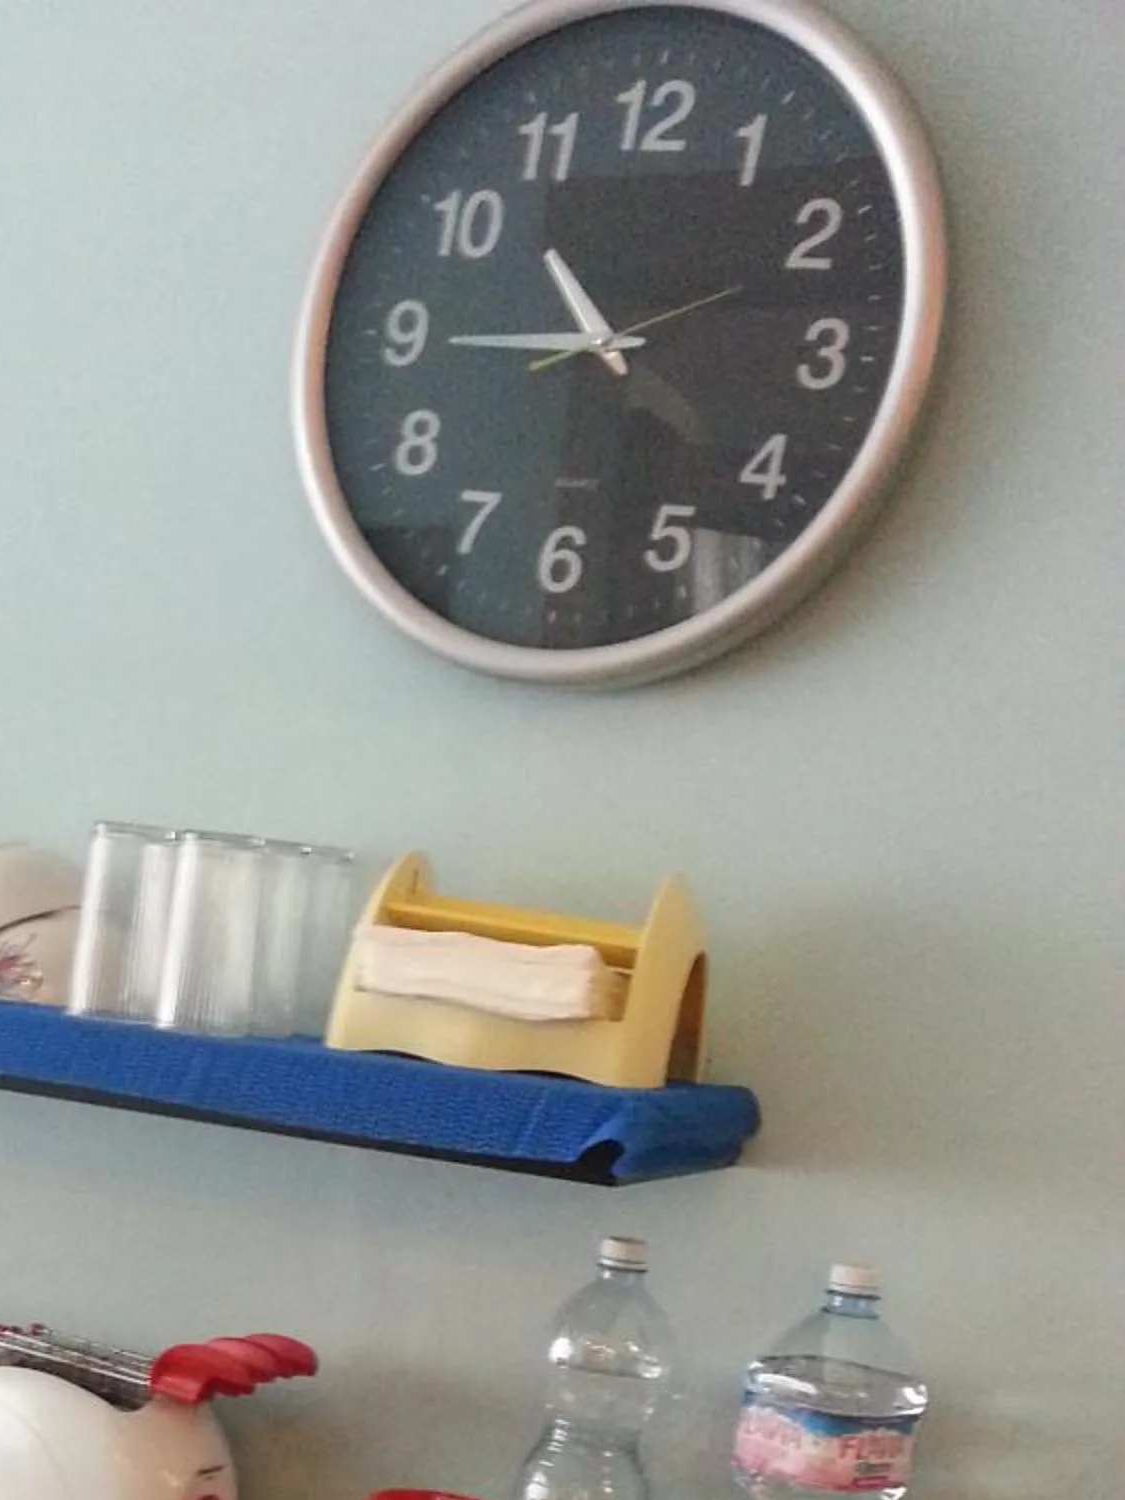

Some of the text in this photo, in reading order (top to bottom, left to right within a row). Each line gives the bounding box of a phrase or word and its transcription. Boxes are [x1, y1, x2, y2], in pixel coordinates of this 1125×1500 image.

[519, 111, 579, 181] 11
[615, 79, 696, 152] 12
[735, 113, 767, 186] 1
[434, 189, 503, 259] 10
[784, 197, 843, 270] 2
[384, 299, 429, 367] 9
[796, 317, 850, 390] 3
[395, 409, 441, 476] 8
[739, 433, 787, 500] 4
[458, 489, 502, 554] 7
[645, 504, 695, 572] 5
[537, 525, 586, 593] 6
